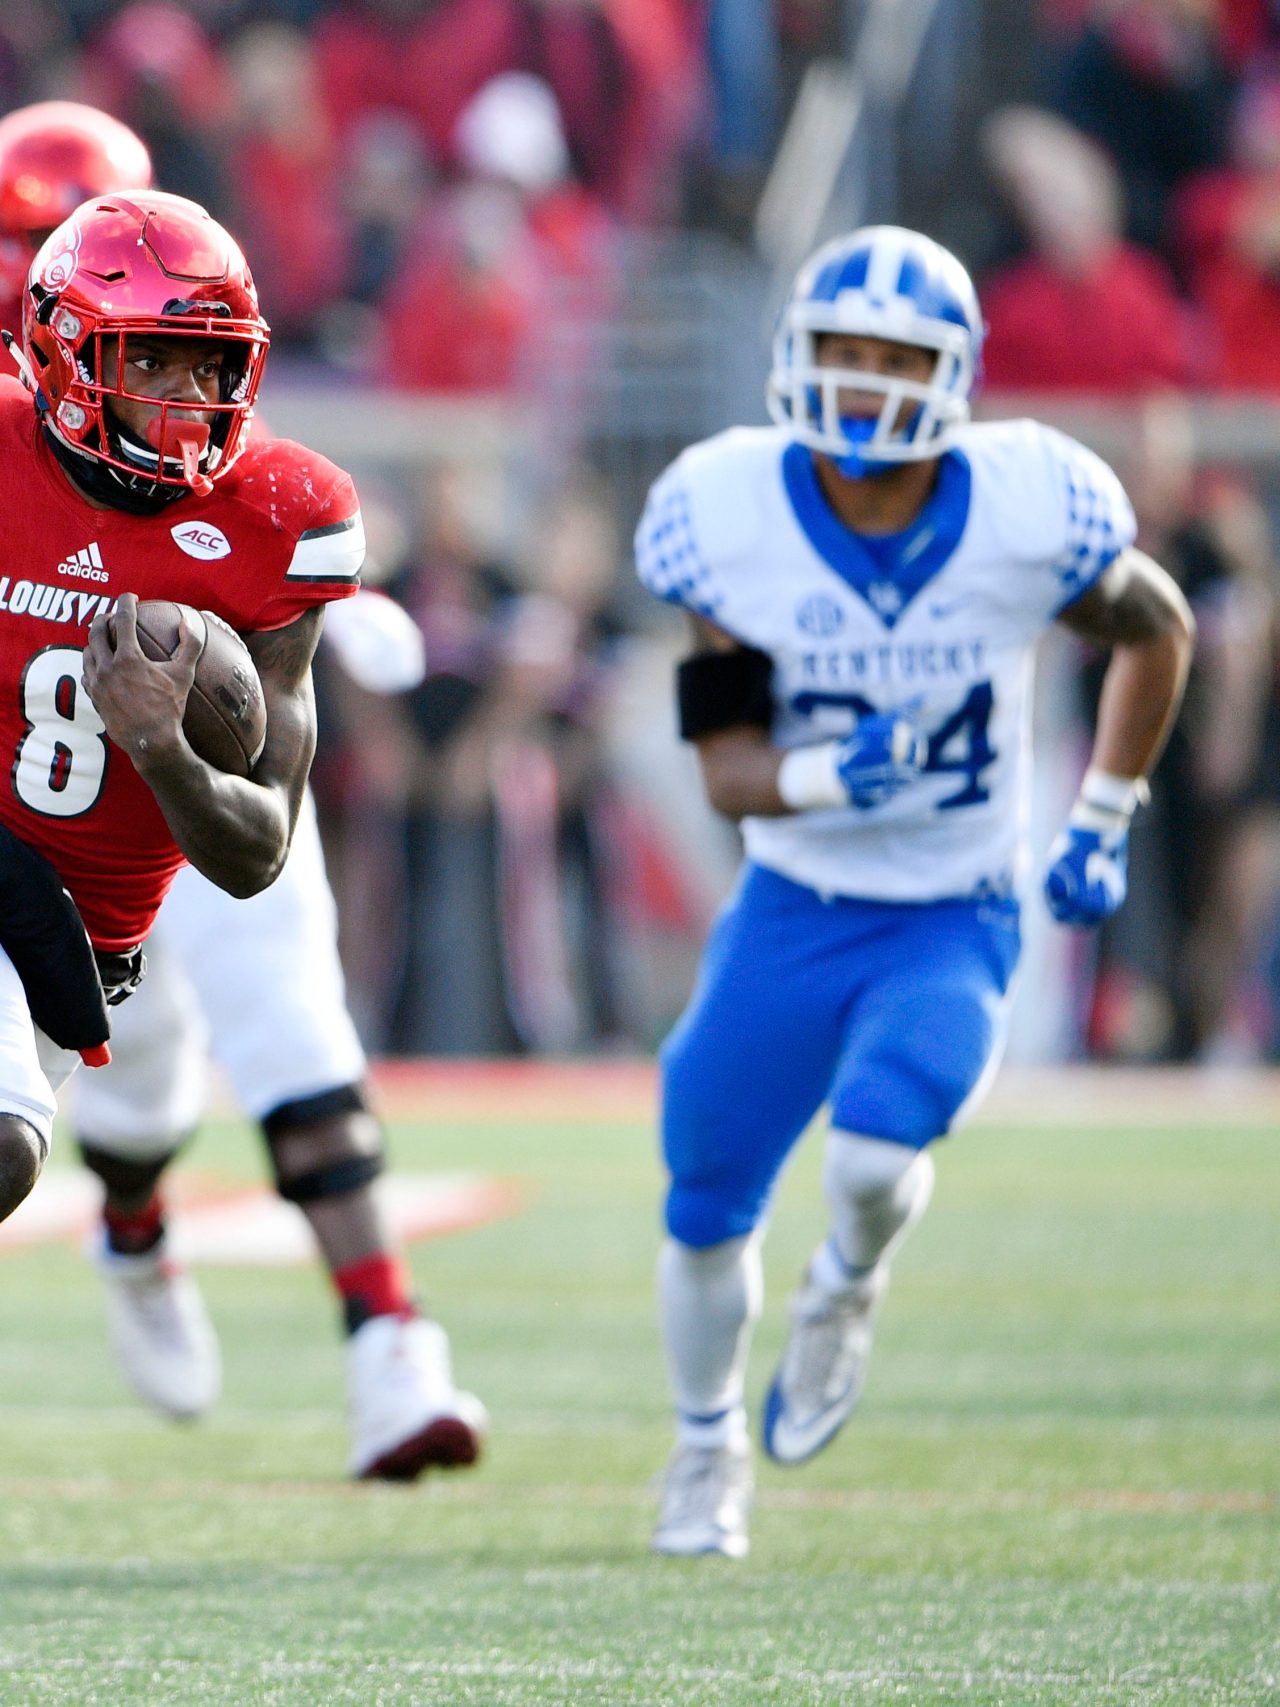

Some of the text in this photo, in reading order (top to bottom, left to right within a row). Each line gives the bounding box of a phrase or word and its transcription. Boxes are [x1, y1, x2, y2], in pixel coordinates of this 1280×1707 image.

[180, 529, 224, 550] ACC
[57, 561, 109, 583] adidas
[12, 644, 109, 819] 8
